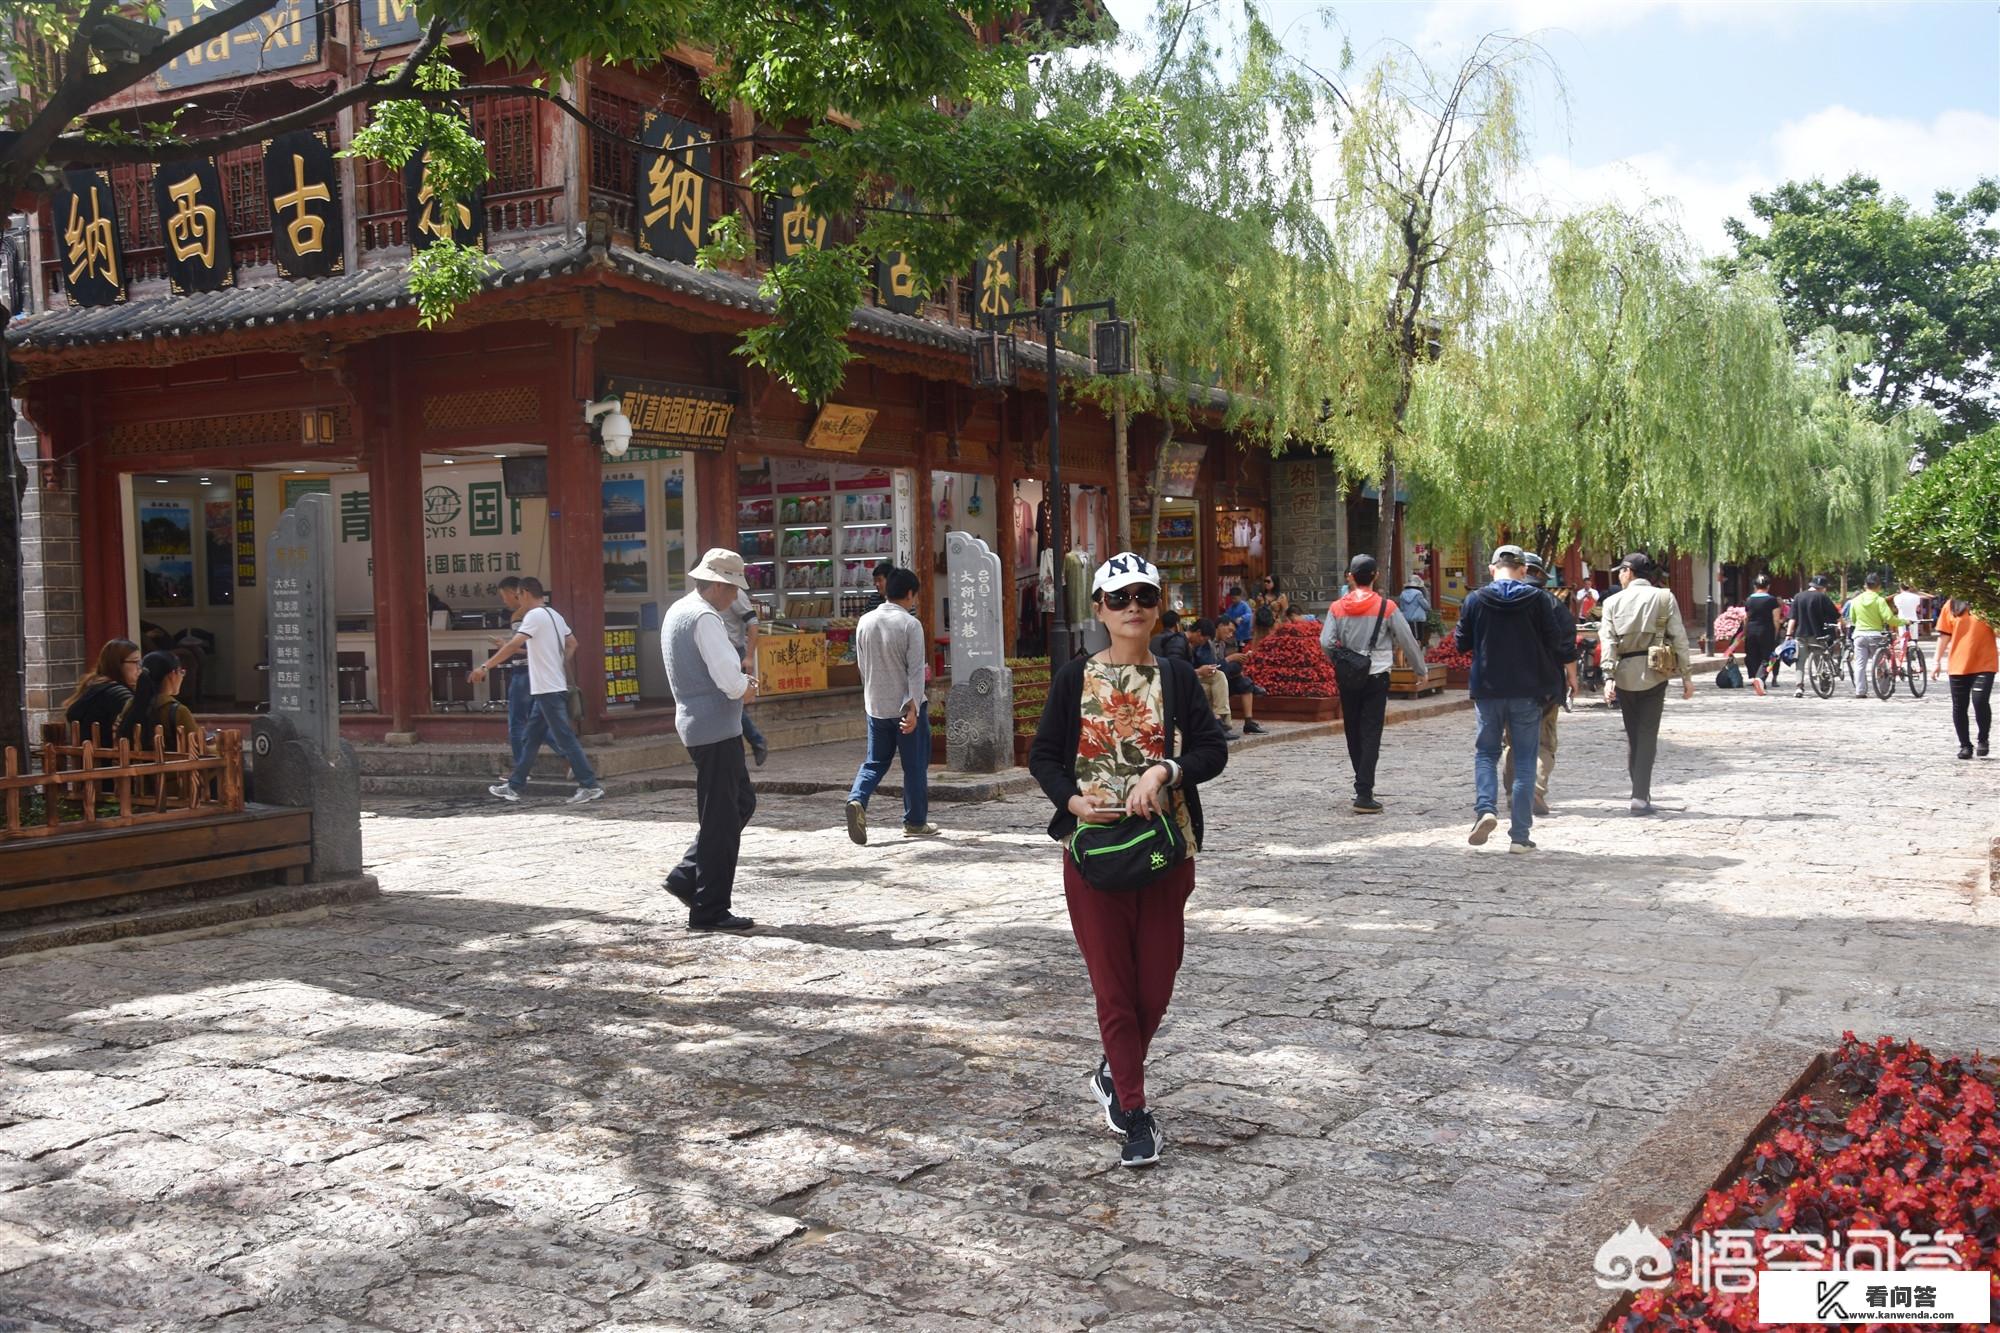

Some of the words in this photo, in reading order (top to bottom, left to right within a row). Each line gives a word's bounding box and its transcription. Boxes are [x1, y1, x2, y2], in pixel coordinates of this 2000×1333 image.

[64, 186, 119, 287] 纳
[167, 173, 217, 269] 西
[273, 153, 331, 257] 古
[643, 133, 704, 249] 纳
[621, 391, 735, 438] 丽江青旅国际旅行社
[1108, 553, 1149, 578] NY
[960, 570, 979, 639] 大研花巷
